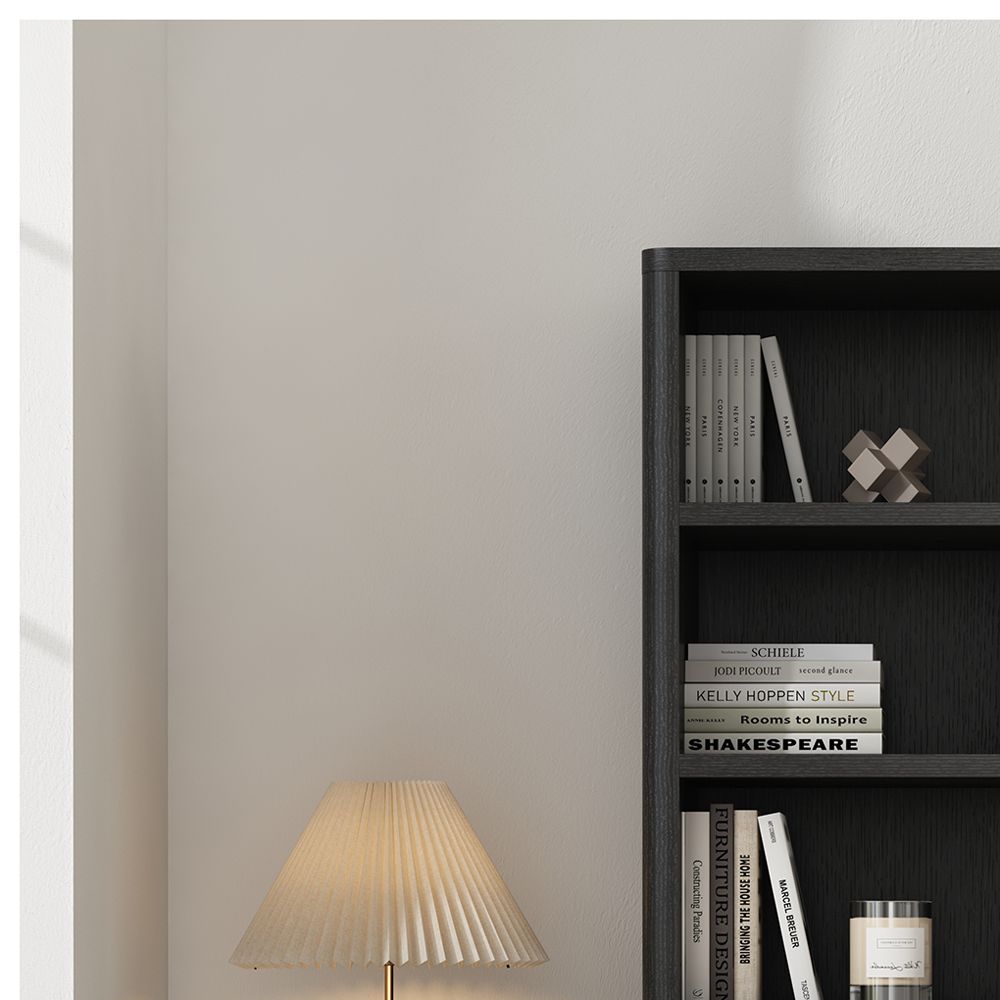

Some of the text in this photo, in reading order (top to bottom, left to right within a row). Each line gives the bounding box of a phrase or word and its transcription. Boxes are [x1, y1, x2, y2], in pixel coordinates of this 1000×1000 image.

[783, 416, 792, 437] PARIS
[751, 647, 805, 658] SCHIELE
[714, 666, 736, 677] JODI
[739, 666, 781, 676] PICOULT
[828, 667, 853, 676] glance
[696, 690, 855, 702] KELLY HOPPEN STYLE
[740, 715, 868, 727] Rooms to Inspire
[688, 738, 859, 751] SHAKESPEARE
[715, 808, 729, 926] FURNITURE
[691, 859, 703, 943] Constructing Paradies
[739, 854, 750, 964] BRINGING THE HOUSE HOME
[779, 879, 800, 948] MARCEL BREUER
